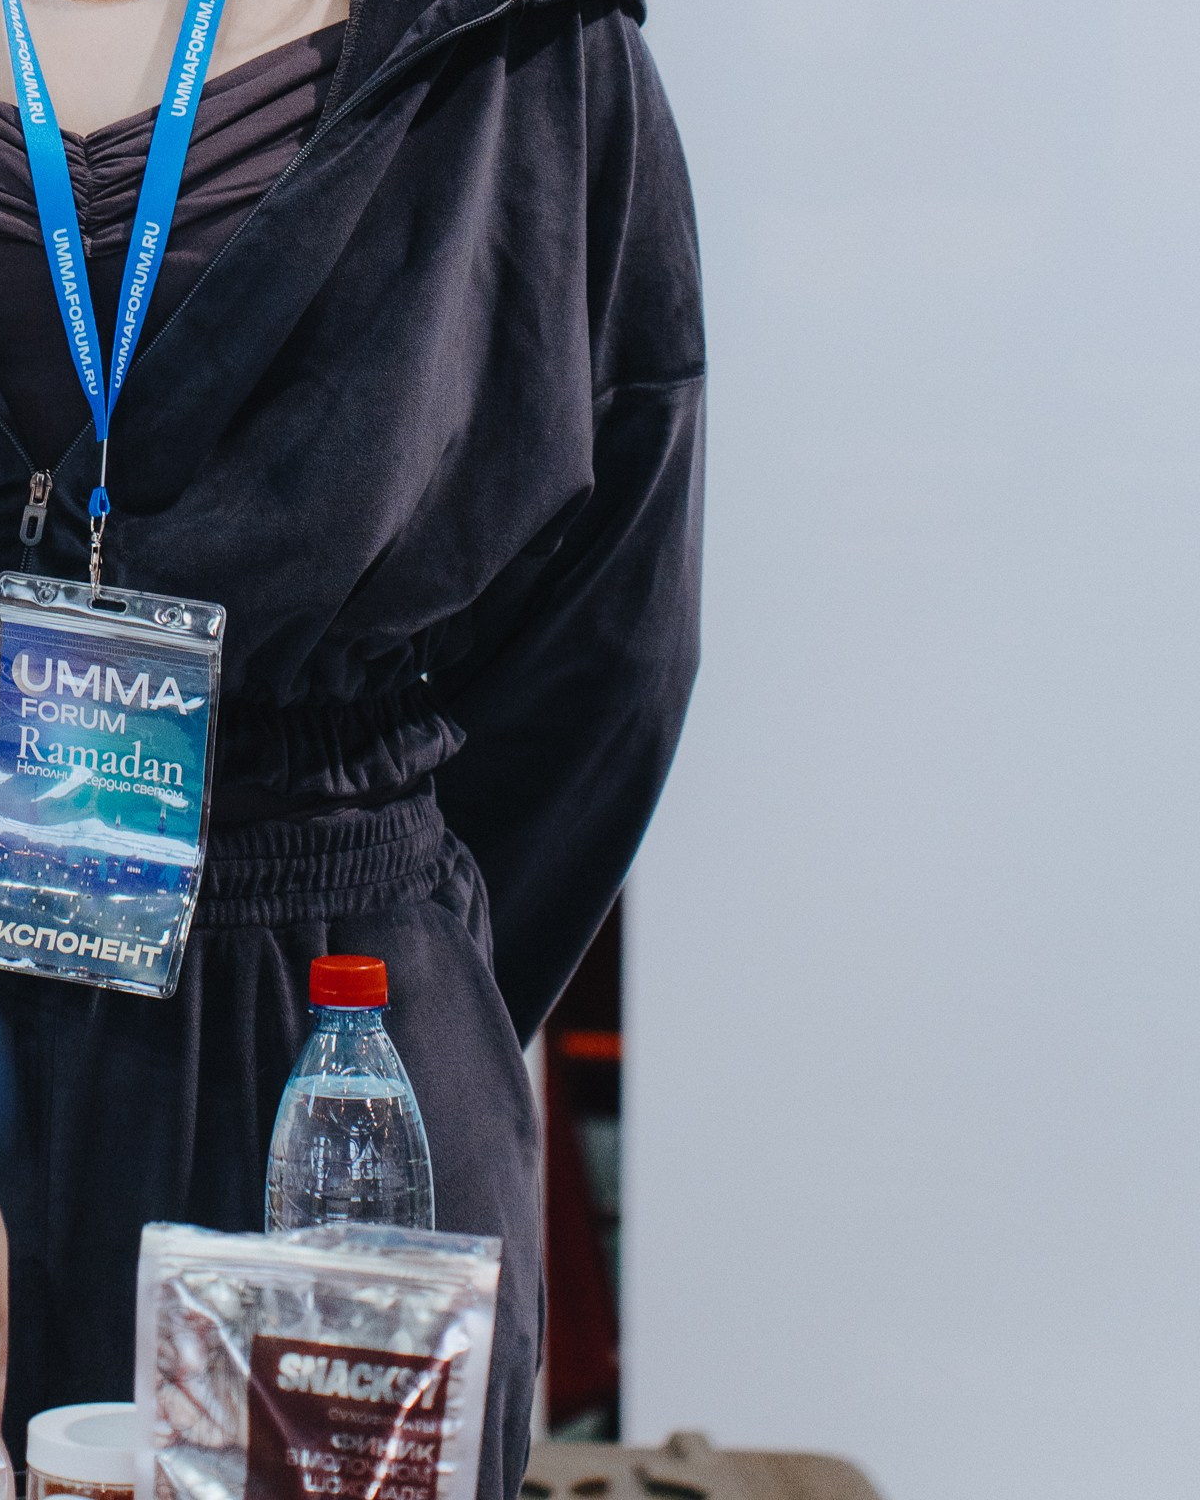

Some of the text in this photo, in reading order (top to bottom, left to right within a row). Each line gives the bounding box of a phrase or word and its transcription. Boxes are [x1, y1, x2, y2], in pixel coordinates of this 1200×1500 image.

[52, 228, 99, 396] UMMAFORUM.RU
[114, 220, 161, 389] UMMAFORUM.RU
[20, 654, 188, 716] UMMA
[21, 697, 126, 735] FORUM
[16, 724, 184, 787] Ramadan
[16, 759, 83, 783] Наполни
